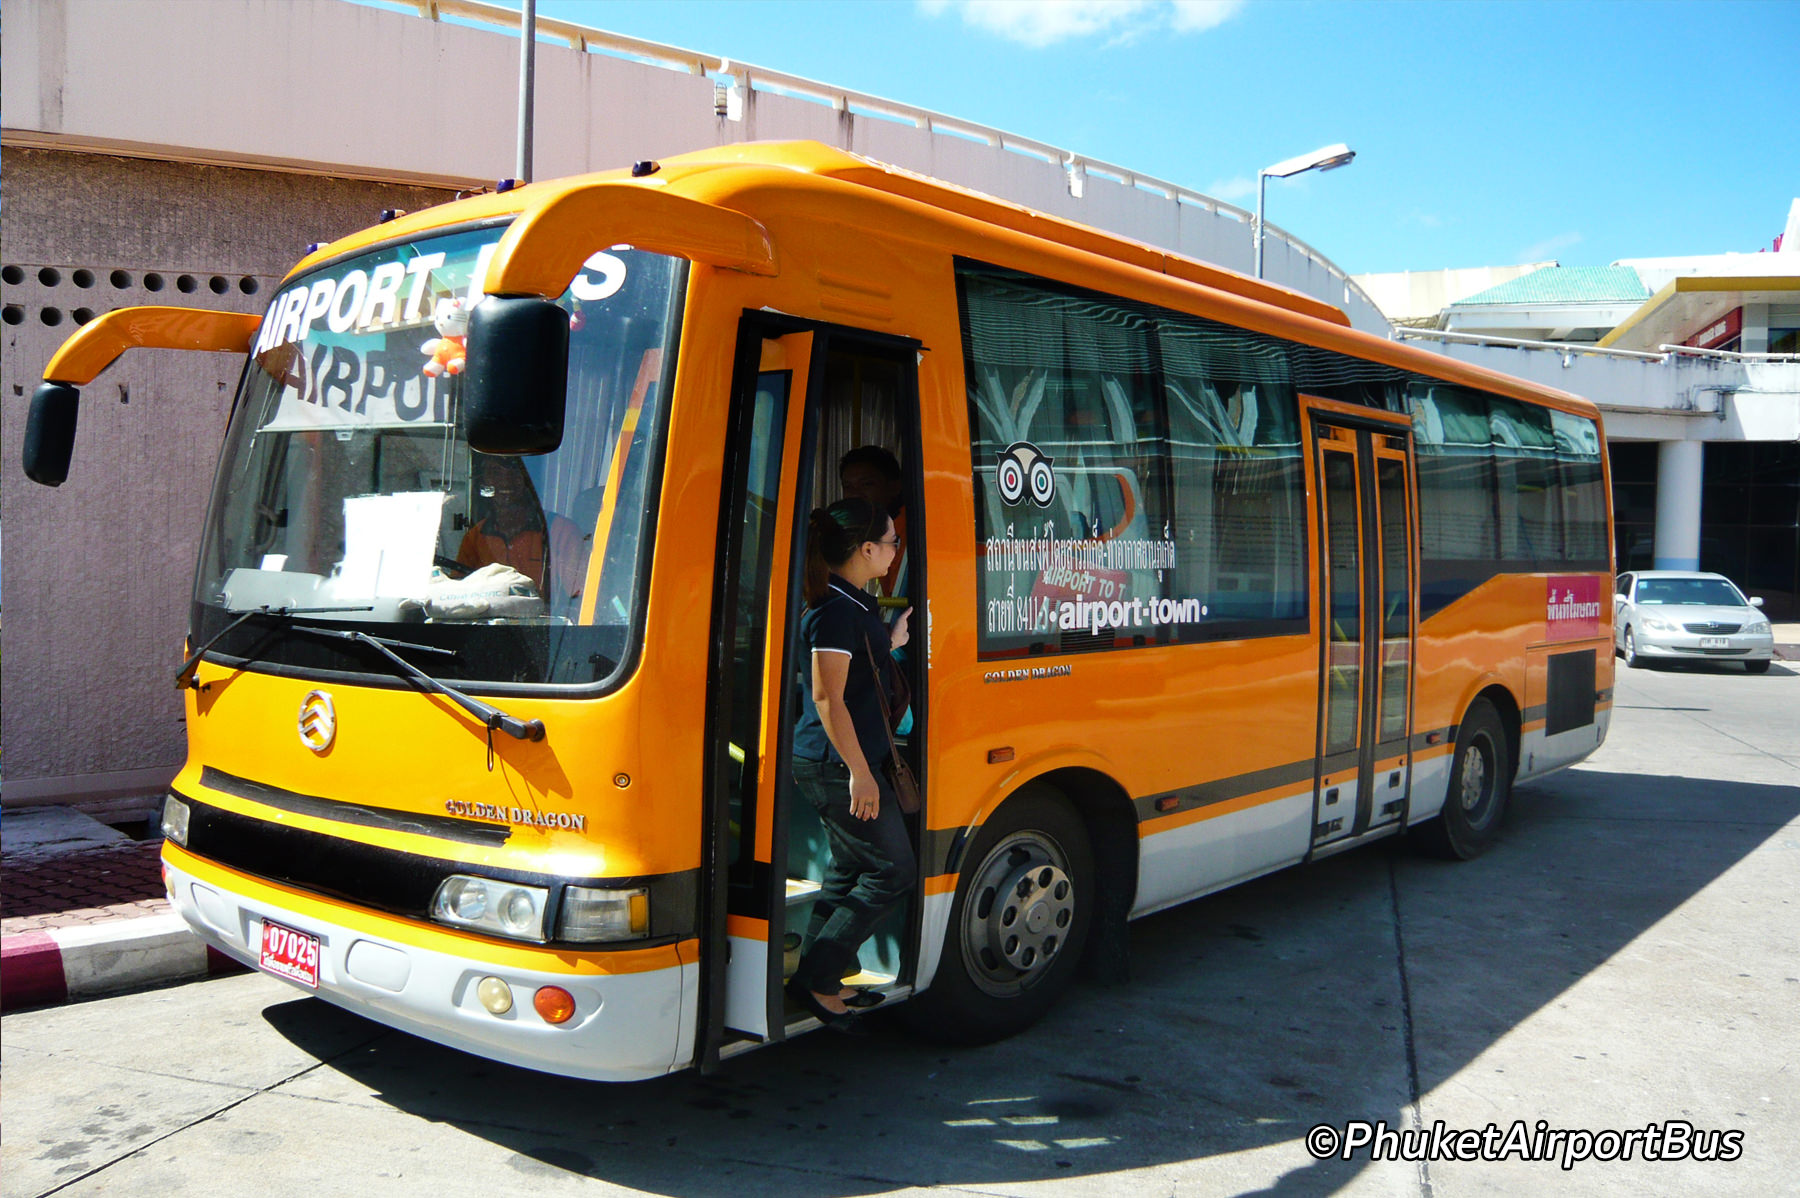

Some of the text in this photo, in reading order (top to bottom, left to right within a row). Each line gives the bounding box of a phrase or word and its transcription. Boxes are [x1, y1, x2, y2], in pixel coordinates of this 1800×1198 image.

[252, 252, 446, 359] AIRPORT
[1043, 566, 1097, 594] AIRPORT
[1099, 579, 1114, 598] TO
[987, 573, 1014, 633] สายที่
[1547, 588, 1600, 621] พื้นที่โฆษณา
[984, 664, 1073, 684] GOLDEN DRAGON
[445, 798, 586, 833] GOLDEN DRAGON
[269, 926, 317, 967] 07025
